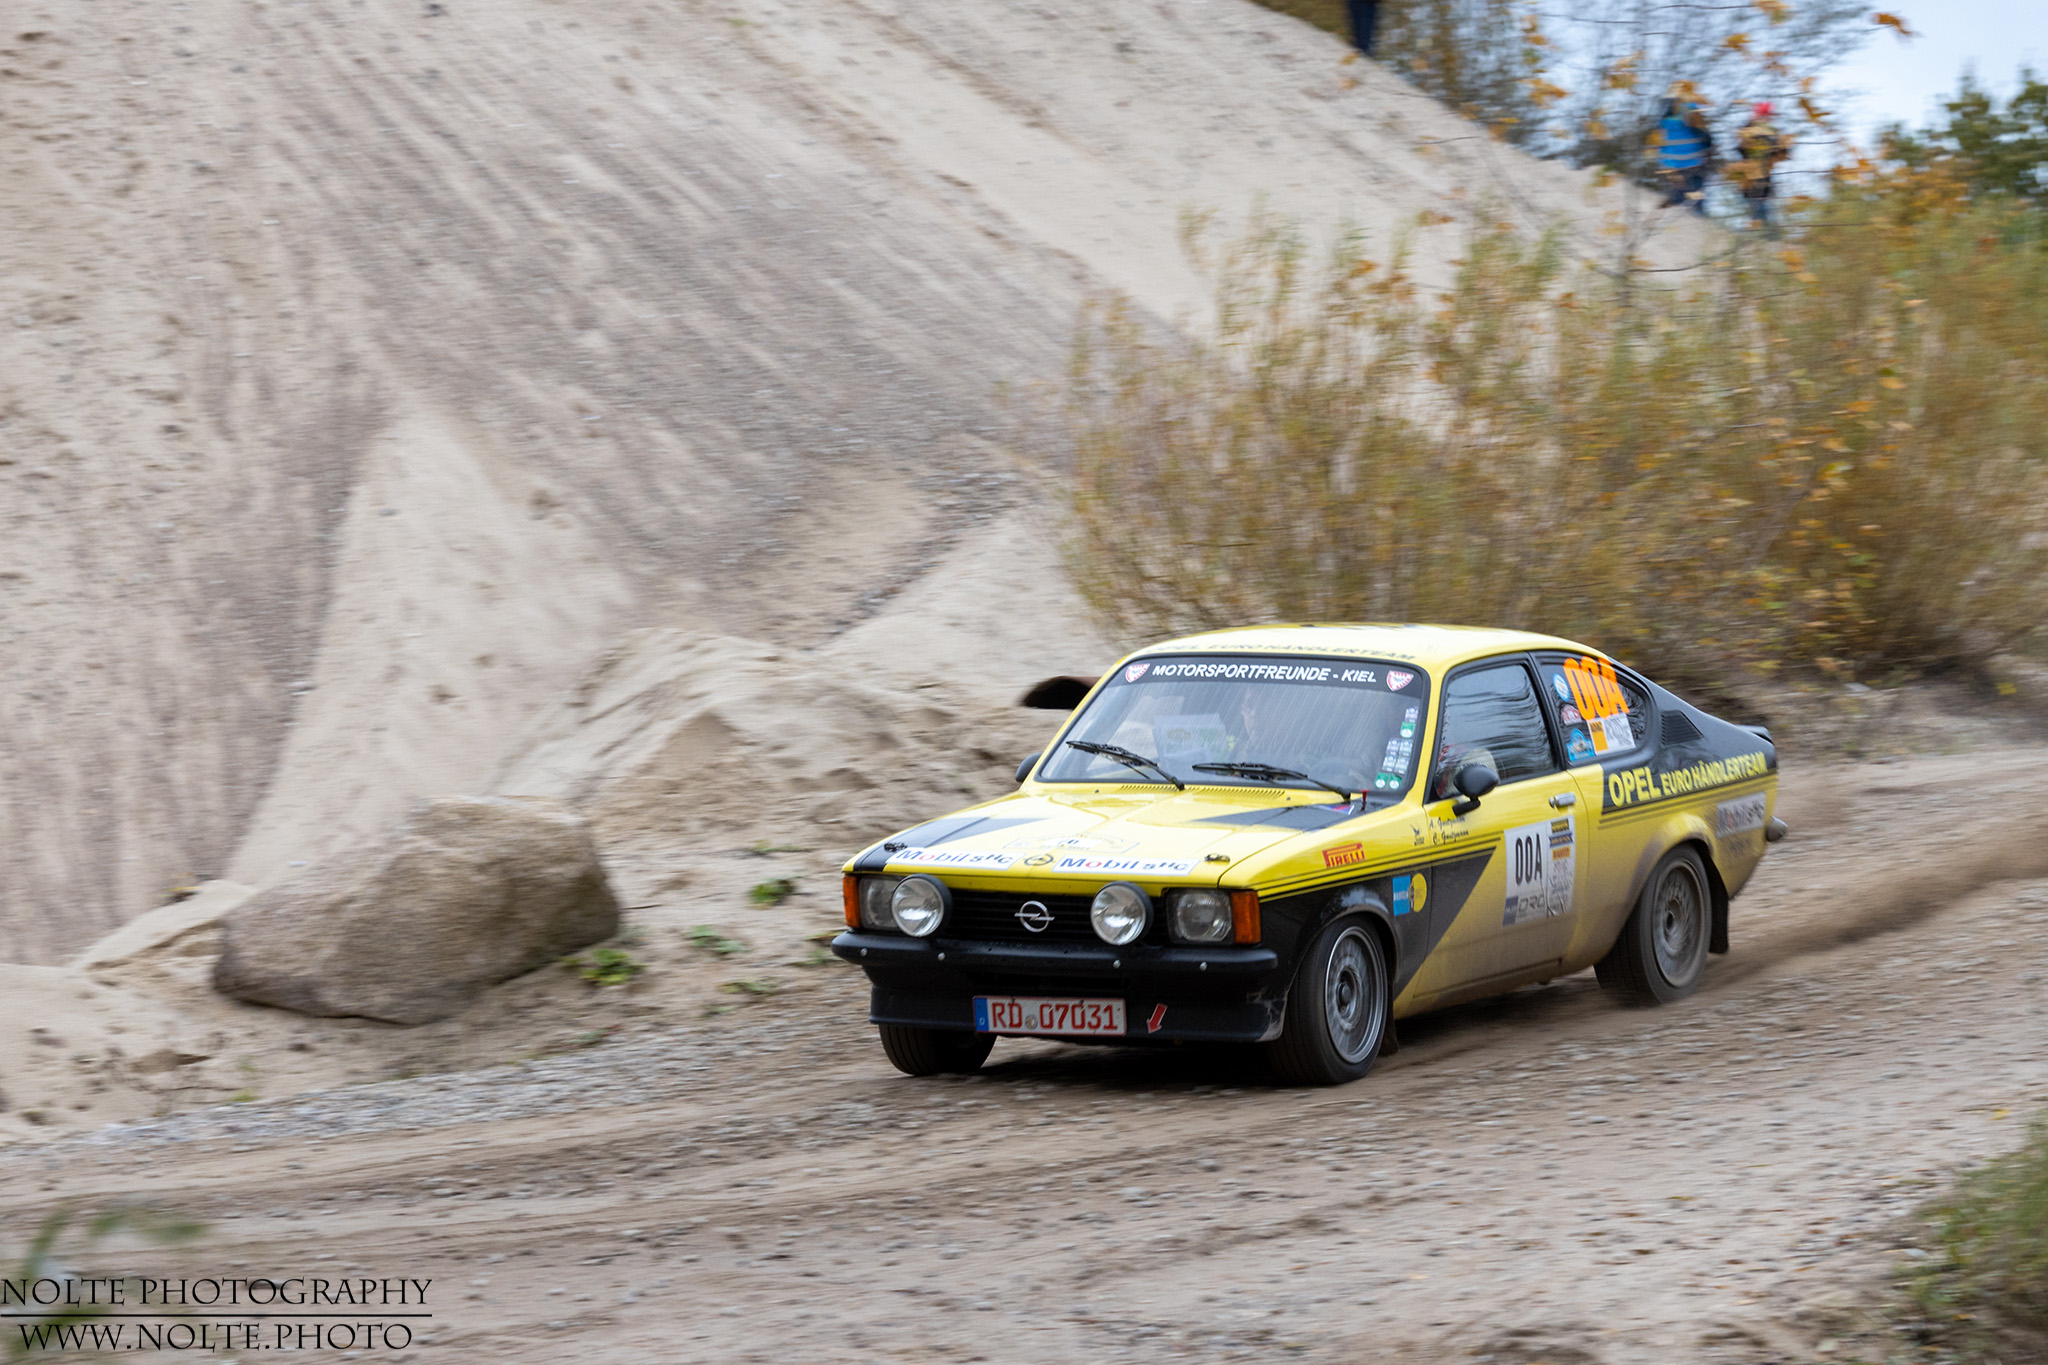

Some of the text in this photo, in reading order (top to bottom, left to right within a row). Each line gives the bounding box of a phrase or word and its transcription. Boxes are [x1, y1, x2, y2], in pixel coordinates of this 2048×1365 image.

[1152, 664, 1331, 681] MOTORSPORTFREUNDE
[1341, 669, 1377, 683] KIEL
[1563, 655, 1630, 721] 00A
[1608, 766, 1662, 807] OPEL
[1660, 768, 1693, 796] EURO
[896, 849, 971, 863] Mobil
[1059, 857, 1140, 870] Mobil
[1322, 843, 1366, 868] PIRELLI
[1515, 833, 1543, 886] 00A
[992, 1003, 1022, 1029] RD
[1040, 1004, 1118, 1031] 07031
